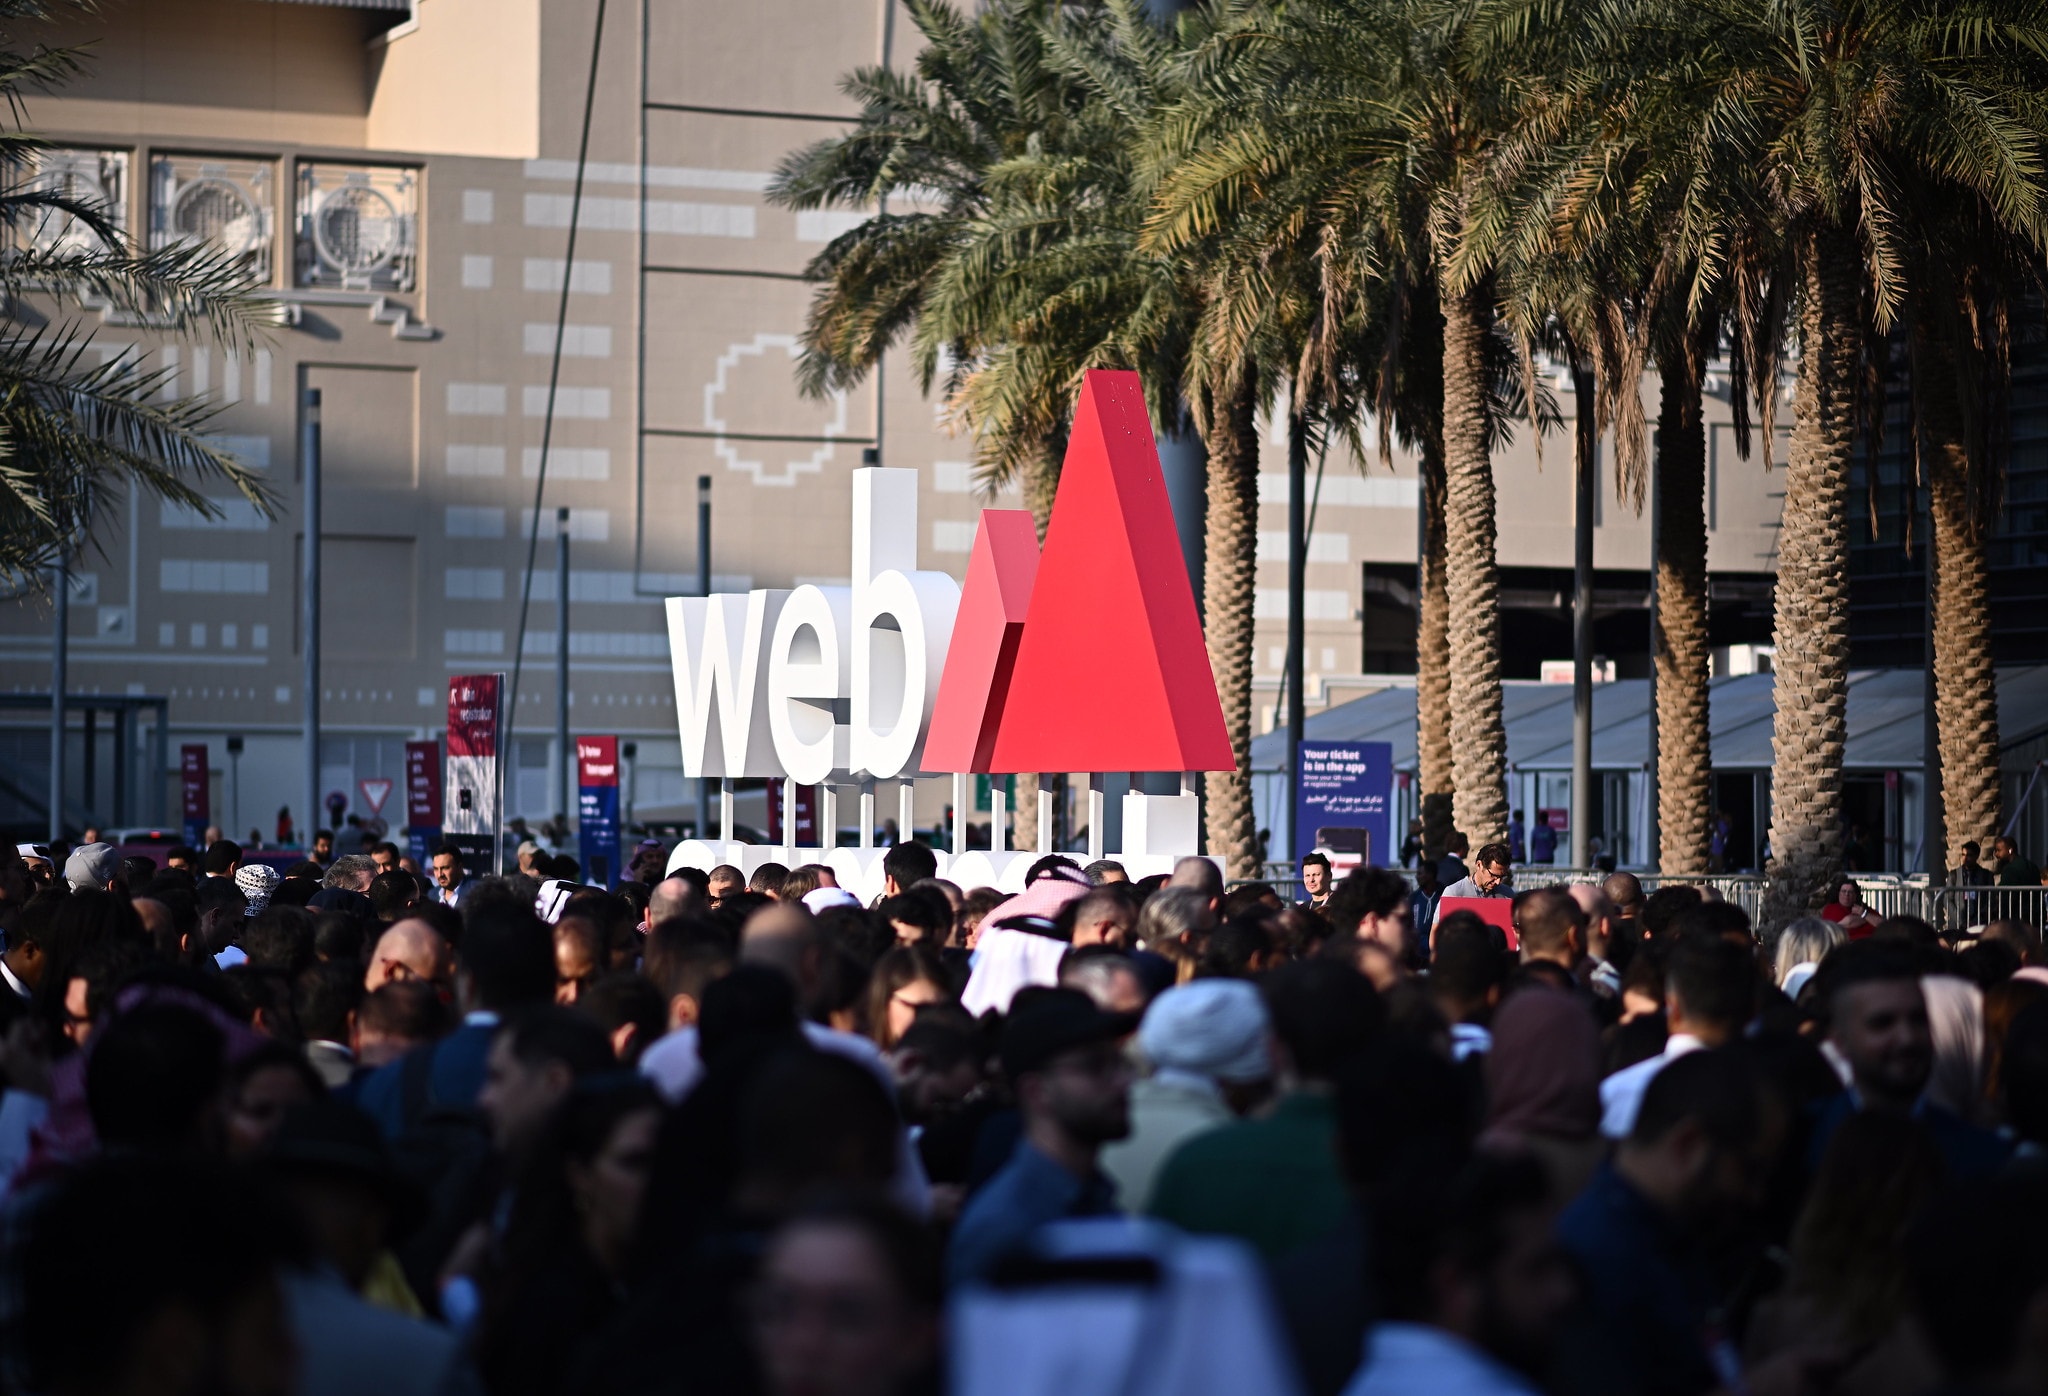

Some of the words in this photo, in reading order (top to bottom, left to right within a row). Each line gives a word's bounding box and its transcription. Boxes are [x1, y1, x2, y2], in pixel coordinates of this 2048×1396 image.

[665, 467, 955, 786] web
[460, 707, 491, 724] registration
[1304, 750, 1328, 760] Your
[1330, 750, 1360, 760] ticket
[1304, 761, 1313, 771] is
[1314, 761, 1325, 771] in
[1326, 761, 1344, 772] the
[1345, 763, 1366, 773] app
